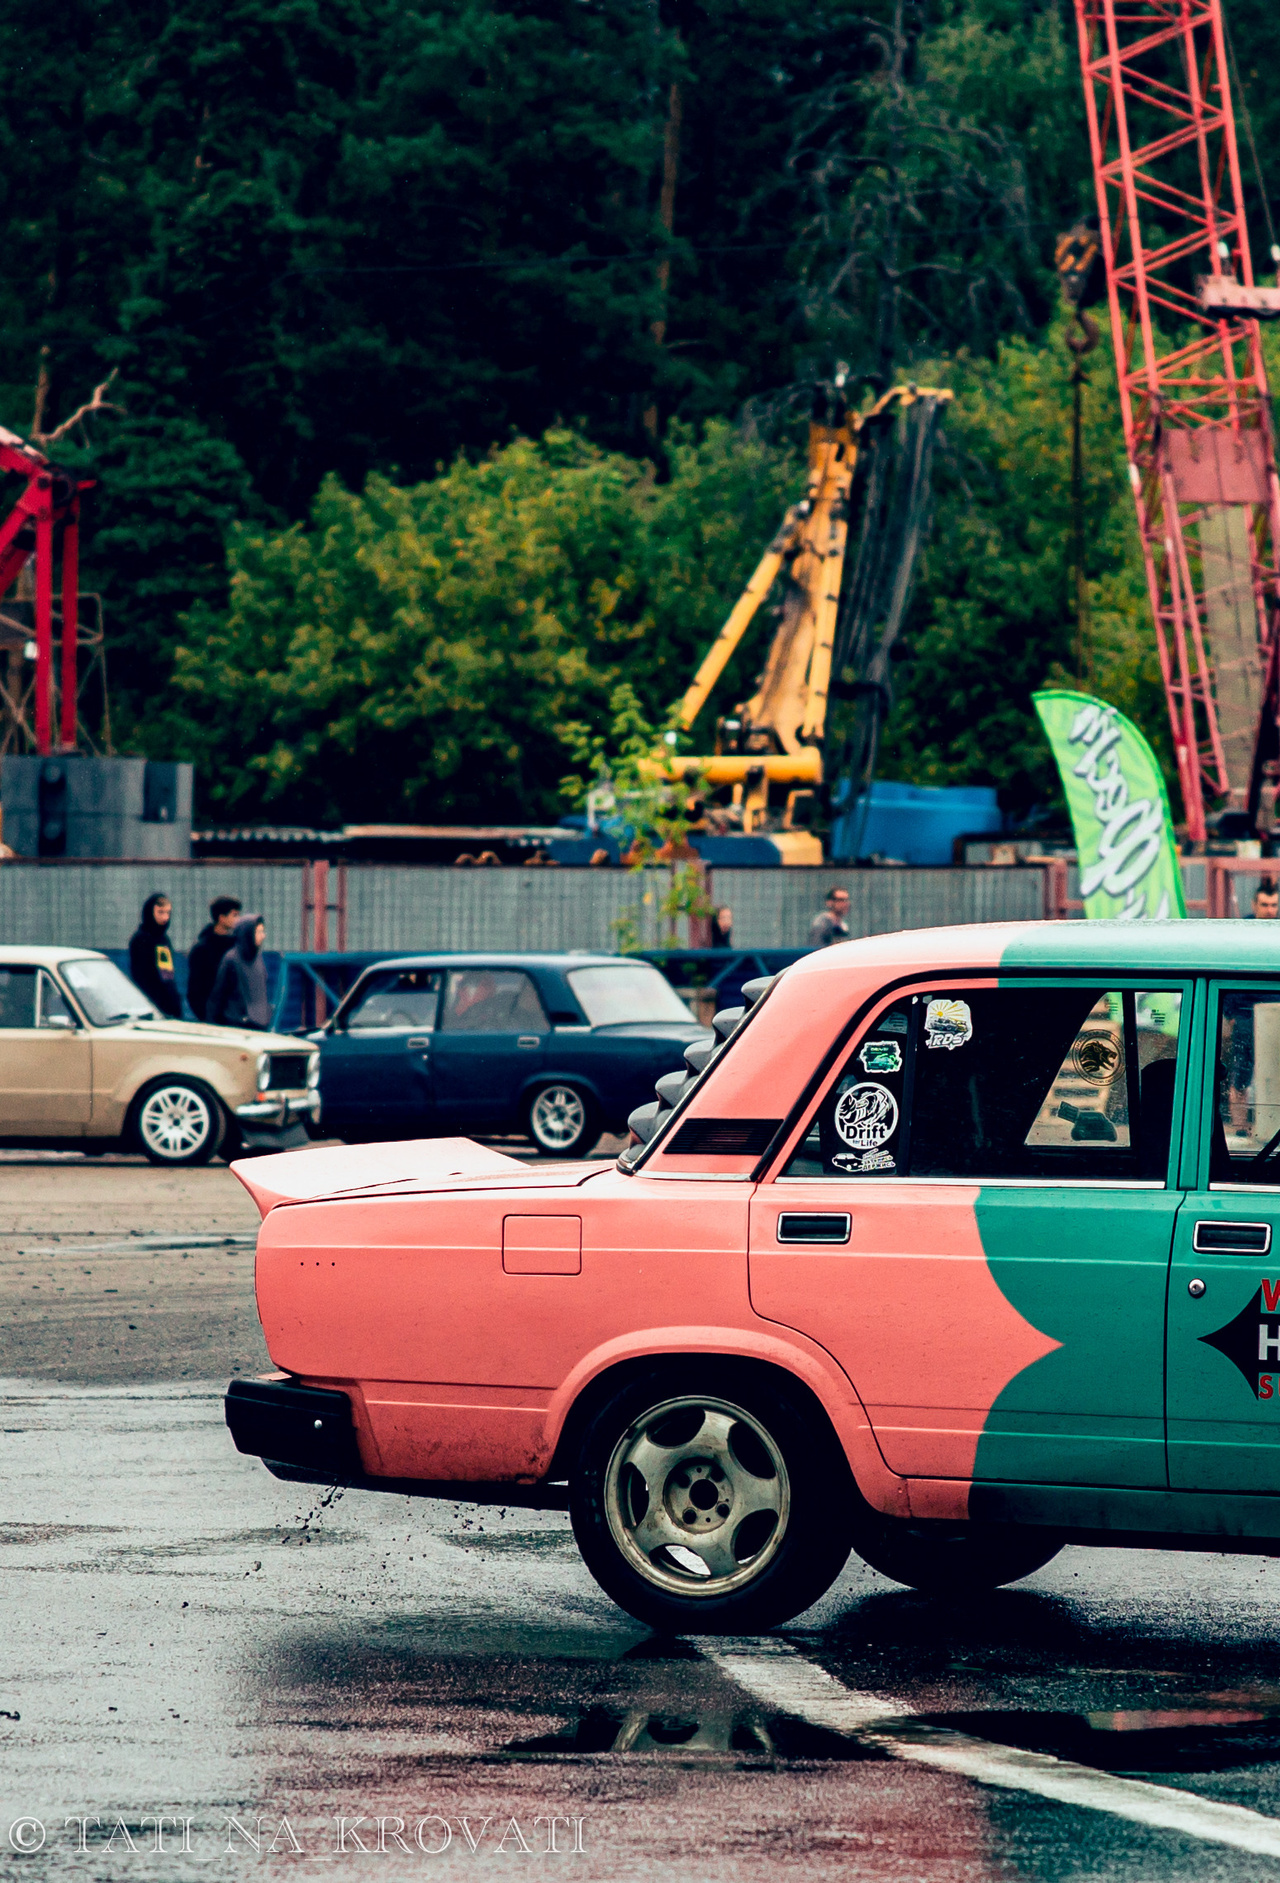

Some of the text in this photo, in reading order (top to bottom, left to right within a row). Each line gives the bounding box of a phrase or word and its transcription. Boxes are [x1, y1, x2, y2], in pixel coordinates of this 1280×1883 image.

[932, 1032, 964, 1046] RDS
[846, 1124, 886, 1139] Drift
[860, 1139, 878, 1147] Life
